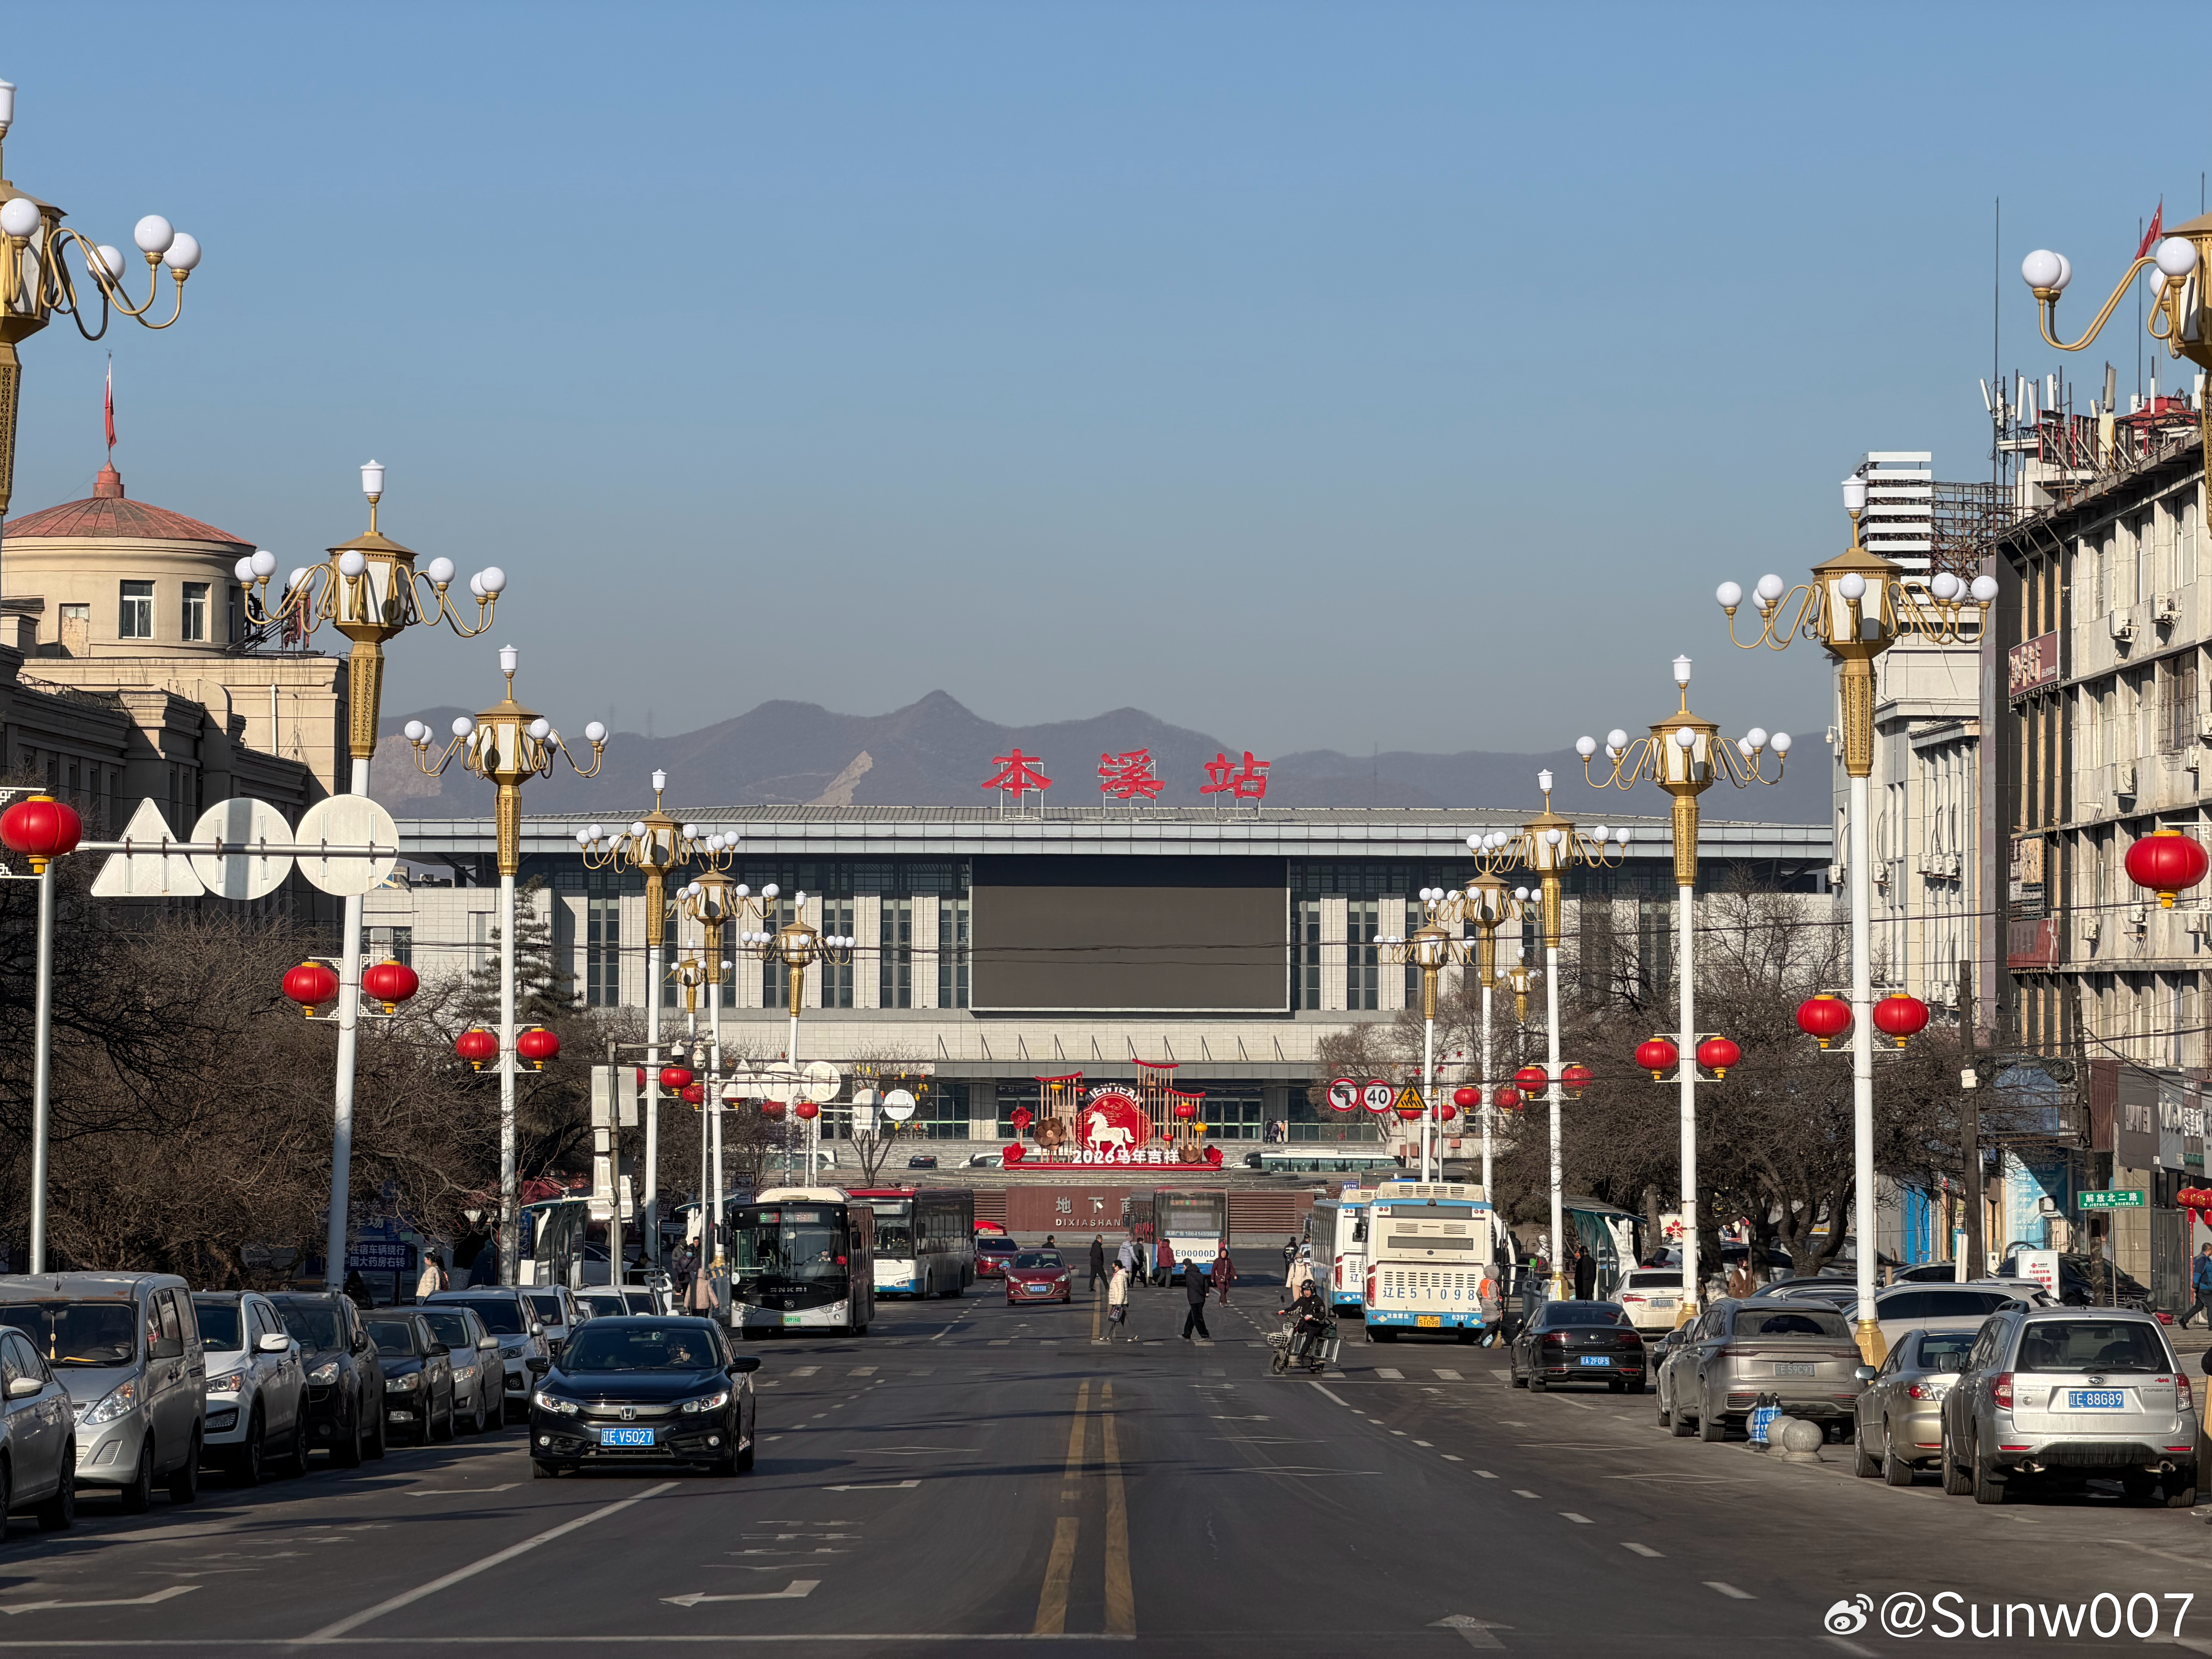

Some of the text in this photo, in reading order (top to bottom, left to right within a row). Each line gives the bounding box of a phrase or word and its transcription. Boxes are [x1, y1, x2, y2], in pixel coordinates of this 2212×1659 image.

[981, 748, 1270, 799] 本溪站
[1367, 1089, 1388, 1104] 40
[1072, 1149, 1180, 1164] 2026马年吉祥
[2086, 1193, 2137, 1202] 解放北二路
[350, 1244, 406, 1255] 住宿车辆绕行
[350, 1256, 405, 1267] 国大药房右转
[1383, 1287, 1475, 1300] 辽E51098
